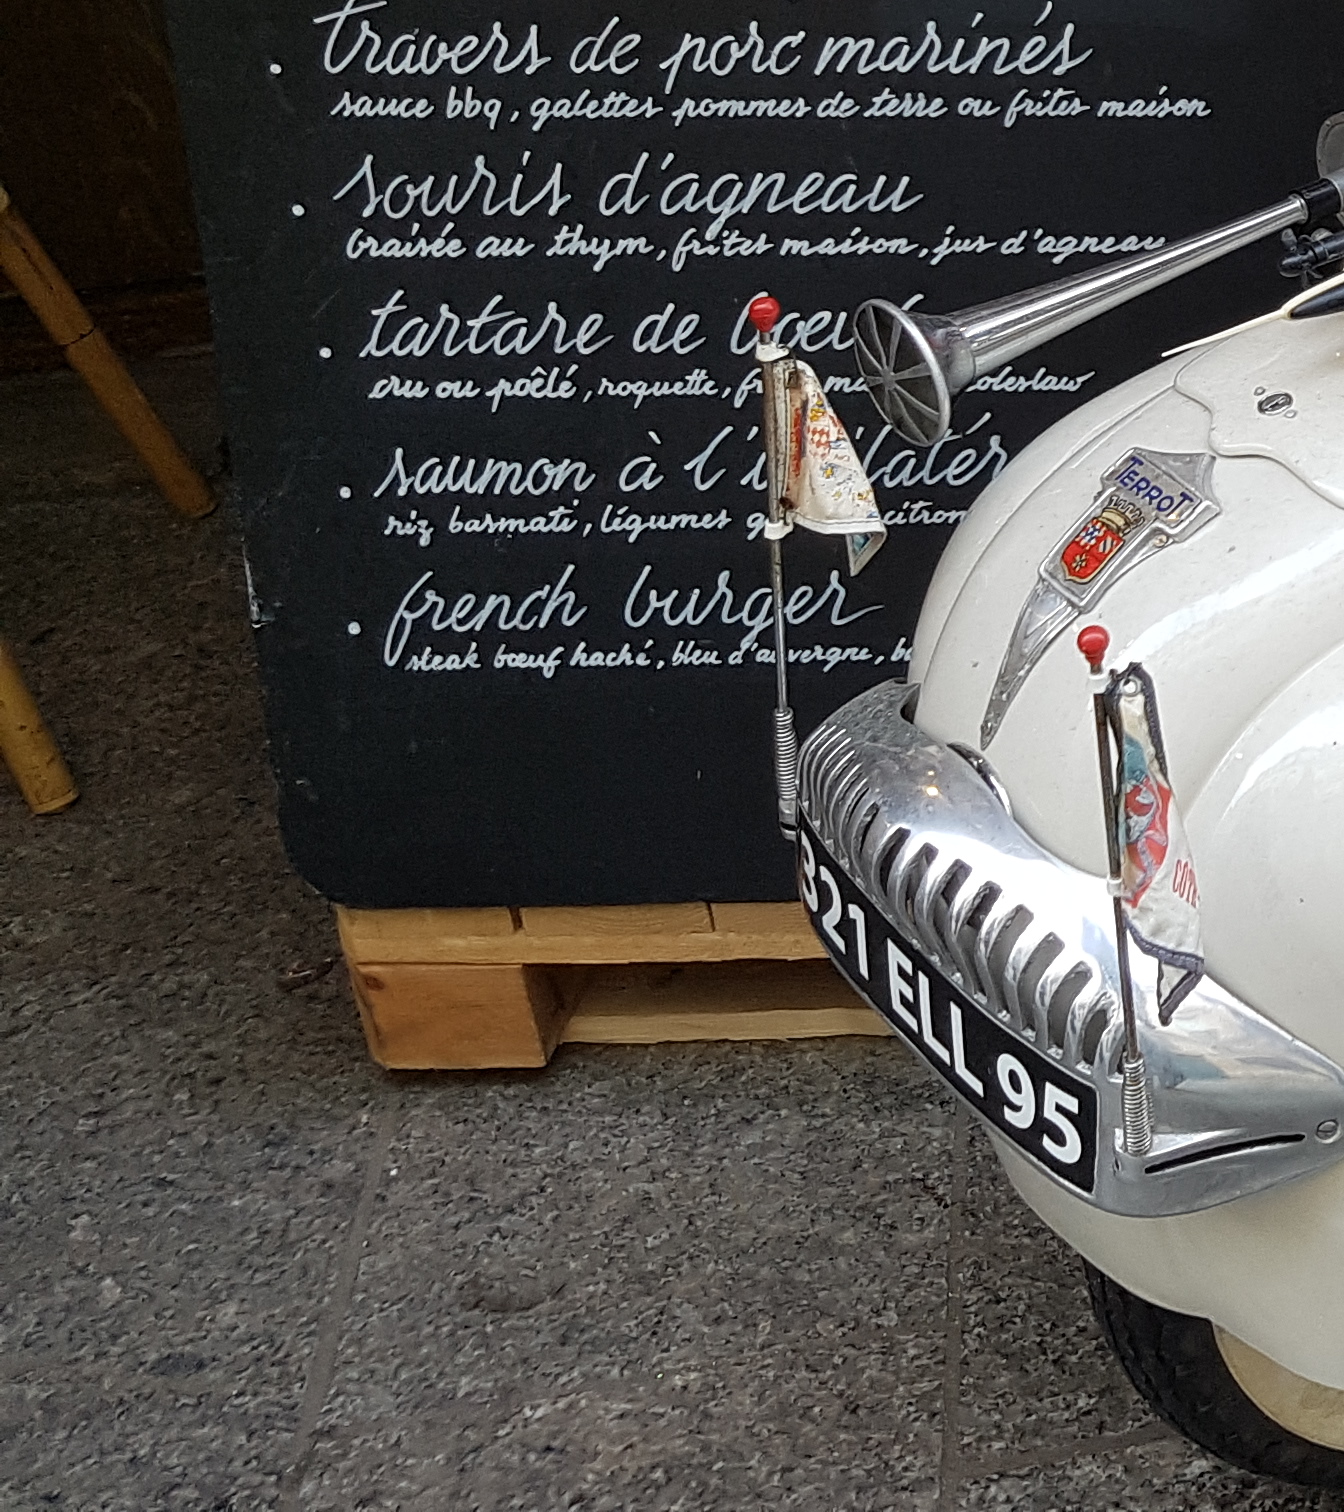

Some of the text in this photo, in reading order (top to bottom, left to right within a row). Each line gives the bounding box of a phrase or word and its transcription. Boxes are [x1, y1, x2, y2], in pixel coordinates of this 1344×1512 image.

[569, 15, 641, 75] de
[660, 21, 806, 94] porc
[813, 0, 1094, 76] marinés
[330, 90, 436, 119] sauce
[531, 88, 663, 131] galettes
[672, 91, 811, 127] pommes
[817, 90, 860, 120] de
[863, 87, 948, 120] terre
[957, 95, 1001, 117] ou
[1003, 88, 1091, 128] frites
[1097, 85, 1212, 119] maison
[333, 150, 924, 239] souris d'agneau
[346, 222, 467, 259] braisée
[475, 237, 535, 259] au
[671, 226, 774, 272] frites
[930, 225, 998, 266] jus
[1000, 228, 1167, 265] d'agneau
[359, 289, 615, 357] tartare
[632, 302, 707, 355] de
[367, 375, 430, 400] cru
[435, 380, 481, 399] ou
[374, 447, 596, 498] saumon
[617, 430, 664, 493] à
[1115, 456, 1194, 518] TERROT
[384, 510, 434, 548] riz
[599, 504, 732, 544] légumes
[384, 563, 884, 668] french burger
[404, 641, 482, 671] steak
[672, 640, 722, 668] bleu
[801, 834, 1082, 1164] 321 ELL 95
